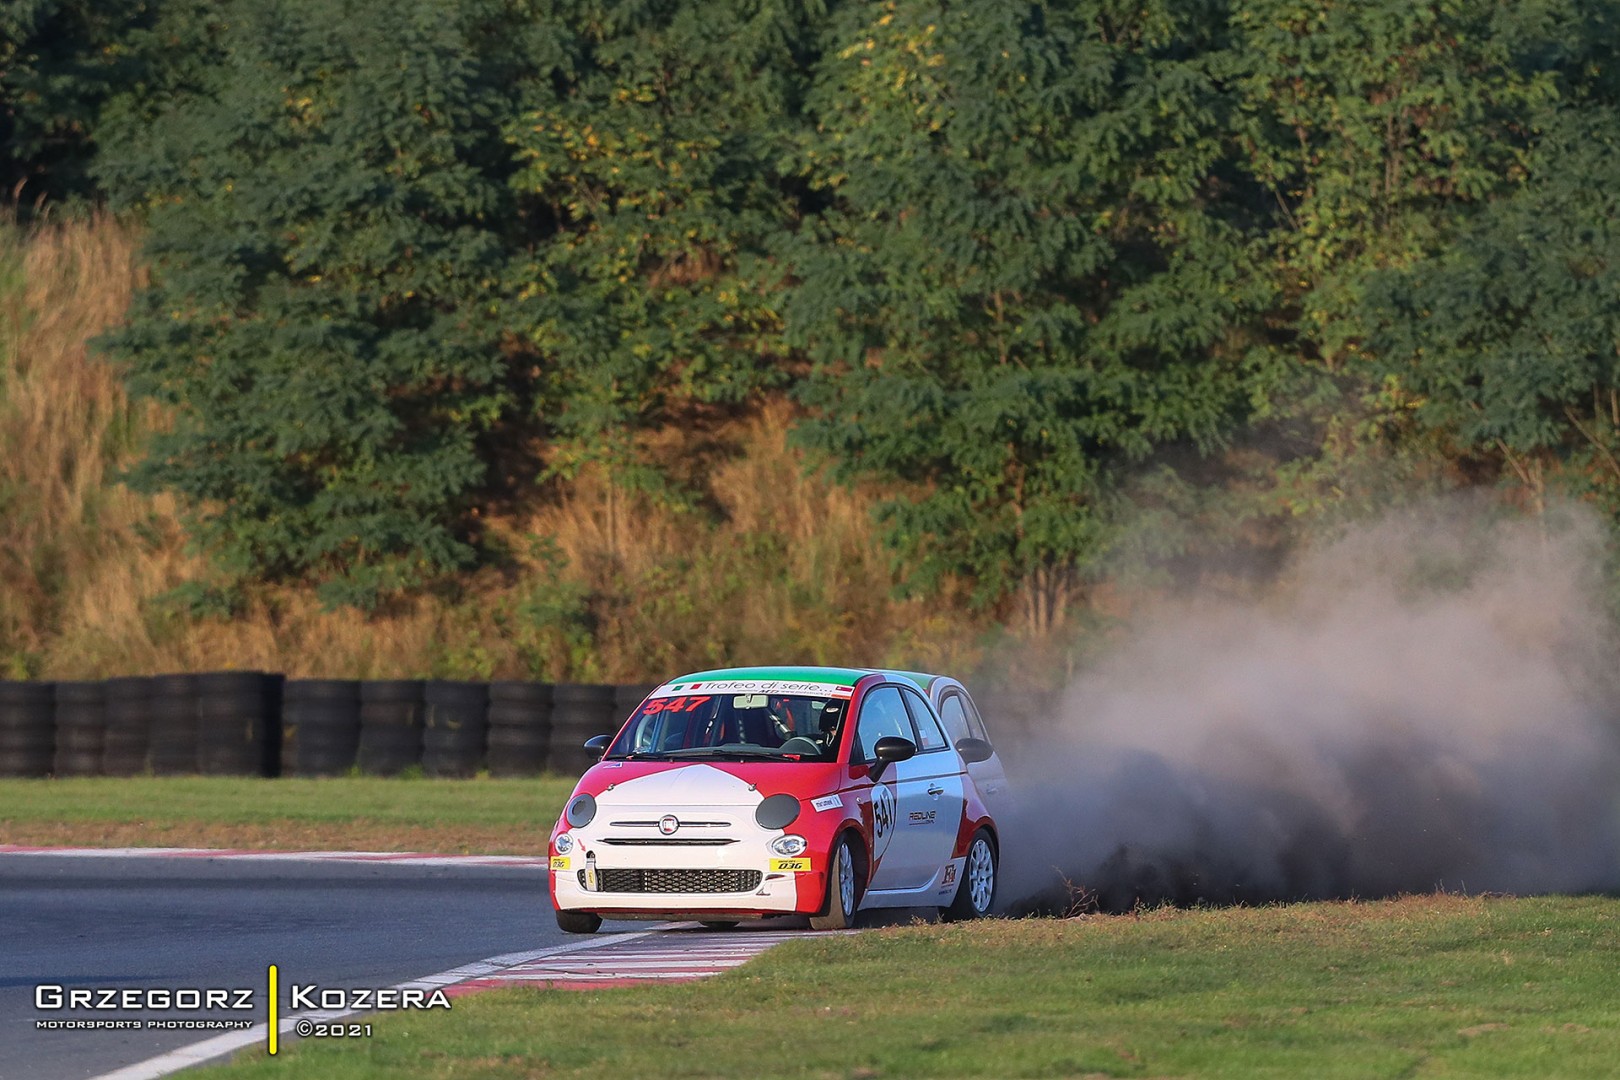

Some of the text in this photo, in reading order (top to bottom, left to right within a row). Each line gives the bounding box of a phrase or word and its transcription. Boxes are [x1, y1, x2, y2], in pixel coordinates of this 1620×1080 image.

[705, 682, 756, 690] Trofeo
[761, 681, 779, 690] di
[642, 695, 712, 715] 547
[909, 810, 936, 820] REDLINE
